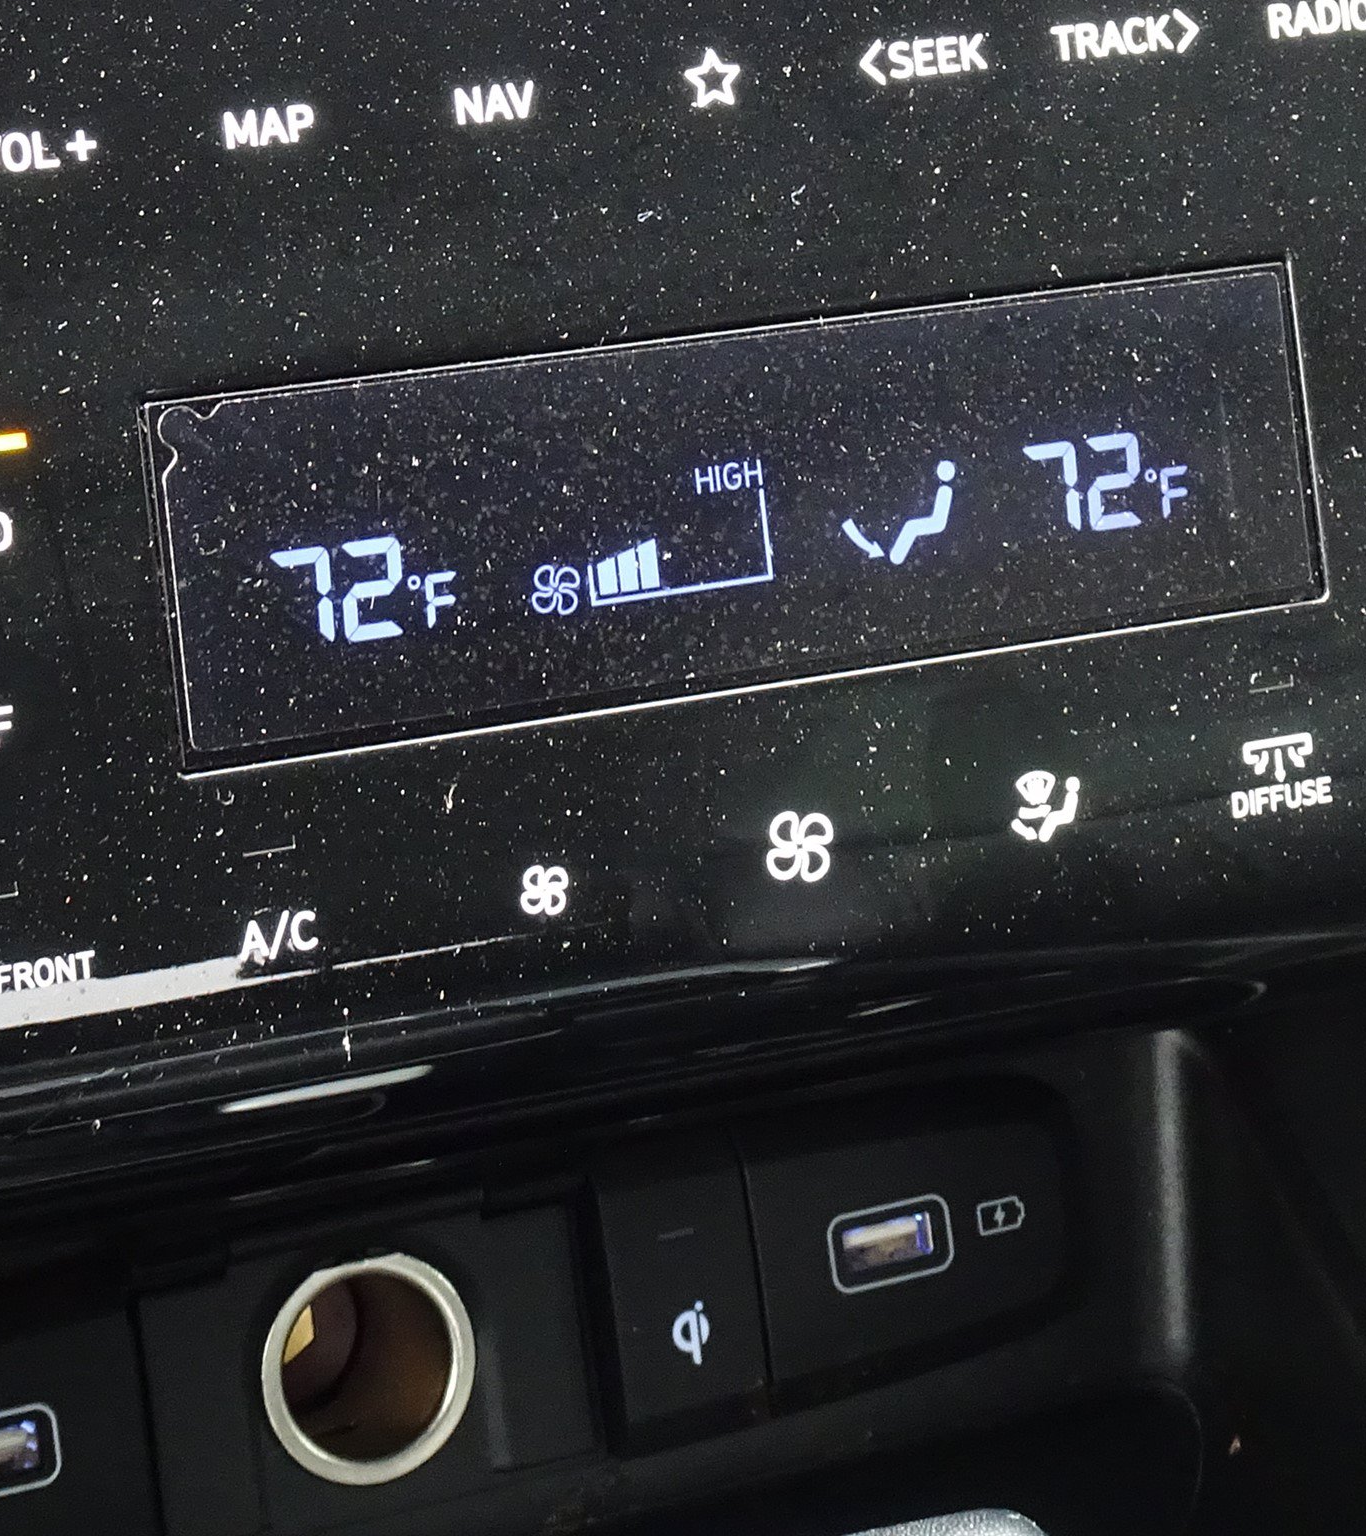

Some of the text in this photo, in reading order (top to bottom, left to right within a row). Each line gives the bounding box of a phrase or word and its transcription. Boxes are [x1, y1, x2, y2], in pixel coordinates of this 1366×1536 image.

[453, 80, 534, 126] NAV
[222, 104, 315, 150] MAP
[693, 459, 765, 495] HIGH
[1230, 775, 1333, 819] DIFFUSE
[240, 908, 320, 962] A/C
